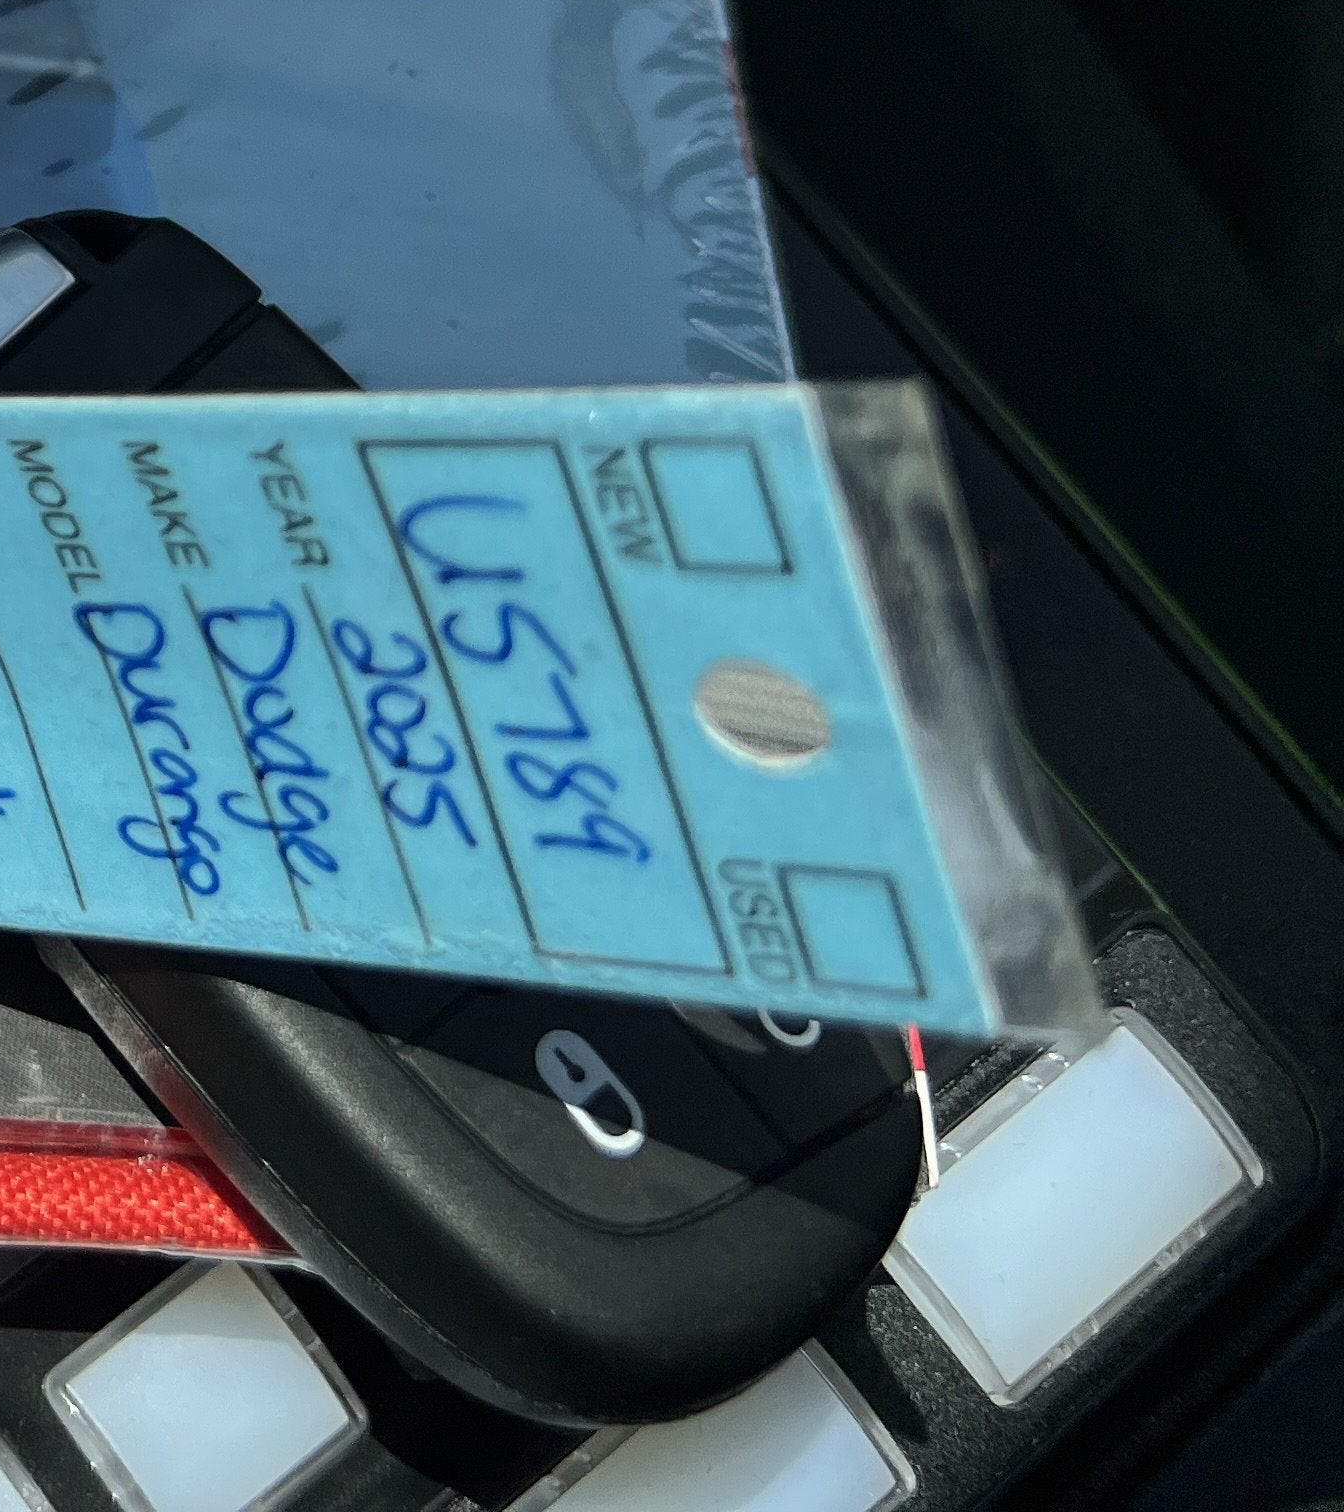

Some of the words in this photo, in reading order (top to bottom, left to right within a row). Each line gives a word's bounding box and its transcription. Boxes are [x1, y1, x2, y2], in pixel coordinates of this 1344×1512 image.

[7, 437, 102, 595] MODEL
[73, 601, 222, 897] Durango
[122, 439, 211, 571] MAKE
[200, 599, 341, 888] Dodge
[248, 439, 332, 570] YEAR
[332, 618, 480, 849] 2025
[585, 443, 663, 568] NEW
[717, 855, 798, 986] USED
